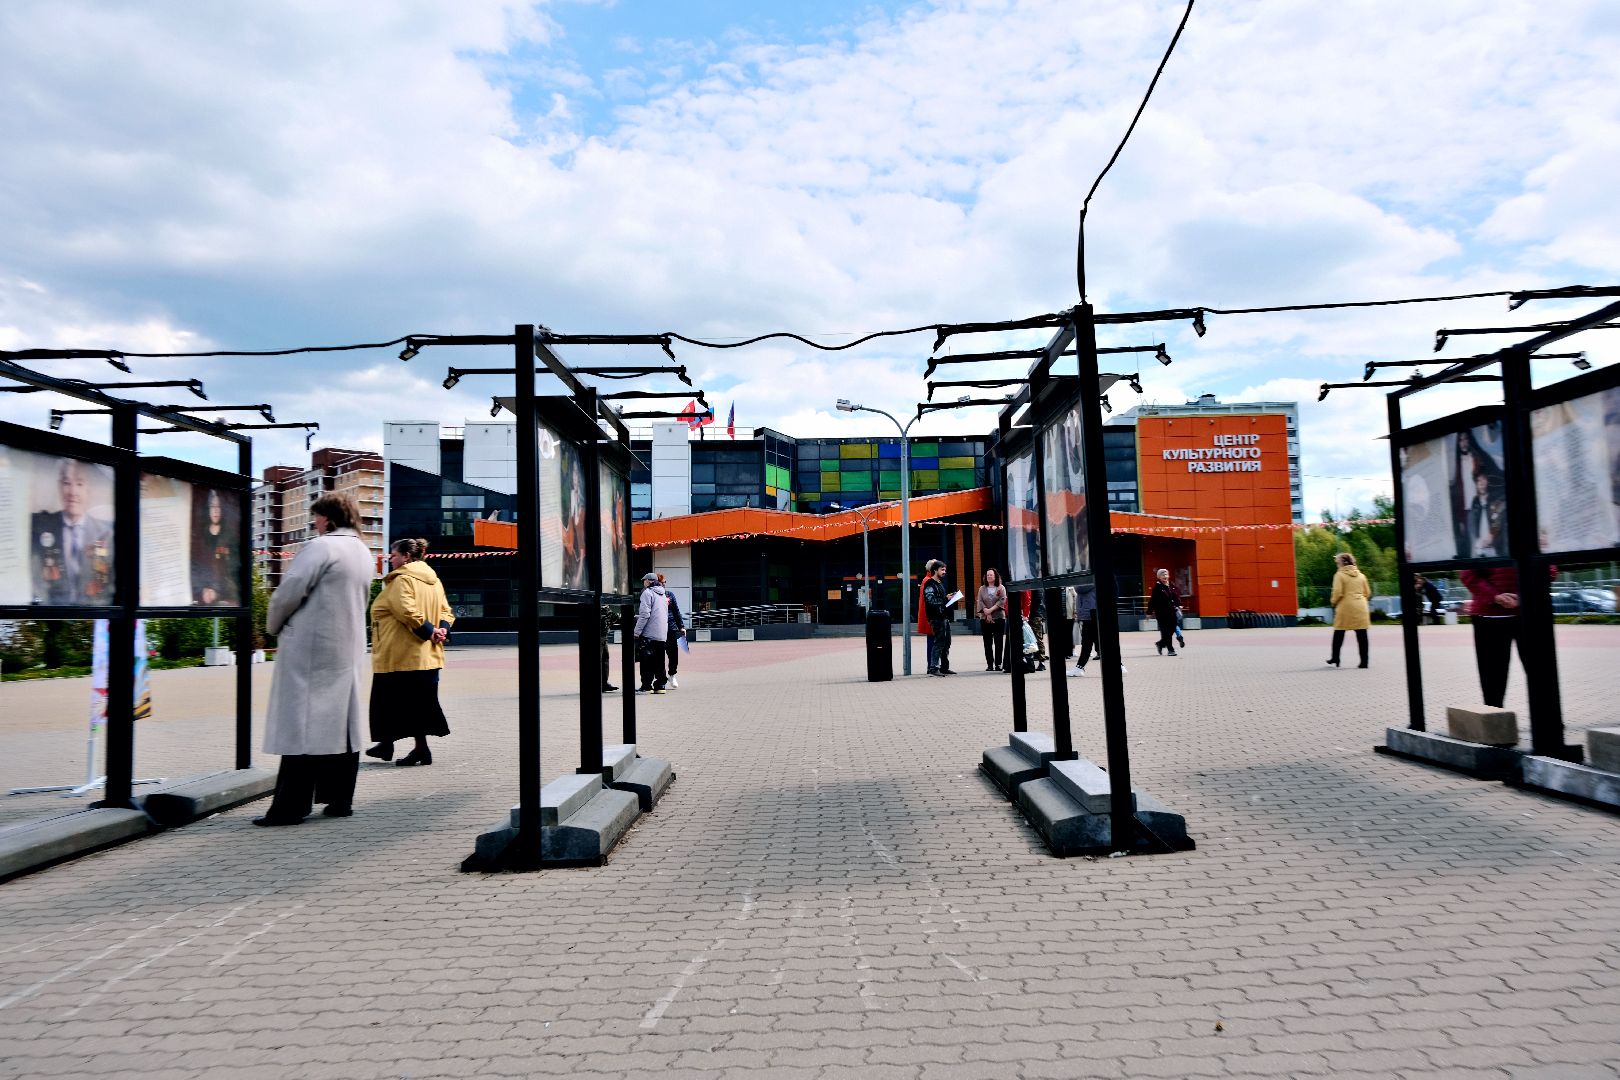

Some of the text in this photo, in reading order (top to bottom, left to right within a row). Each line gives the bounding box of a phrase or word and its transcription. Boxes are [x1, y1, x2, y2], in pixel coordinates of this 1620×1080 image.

[1213, 434, 1260, 448] ЦЕНТР
[1162, 447, 1261, 460] КУЛЬТУРНОГО
[1188, 460, 1262, 473] РАЗВИТИЯ
